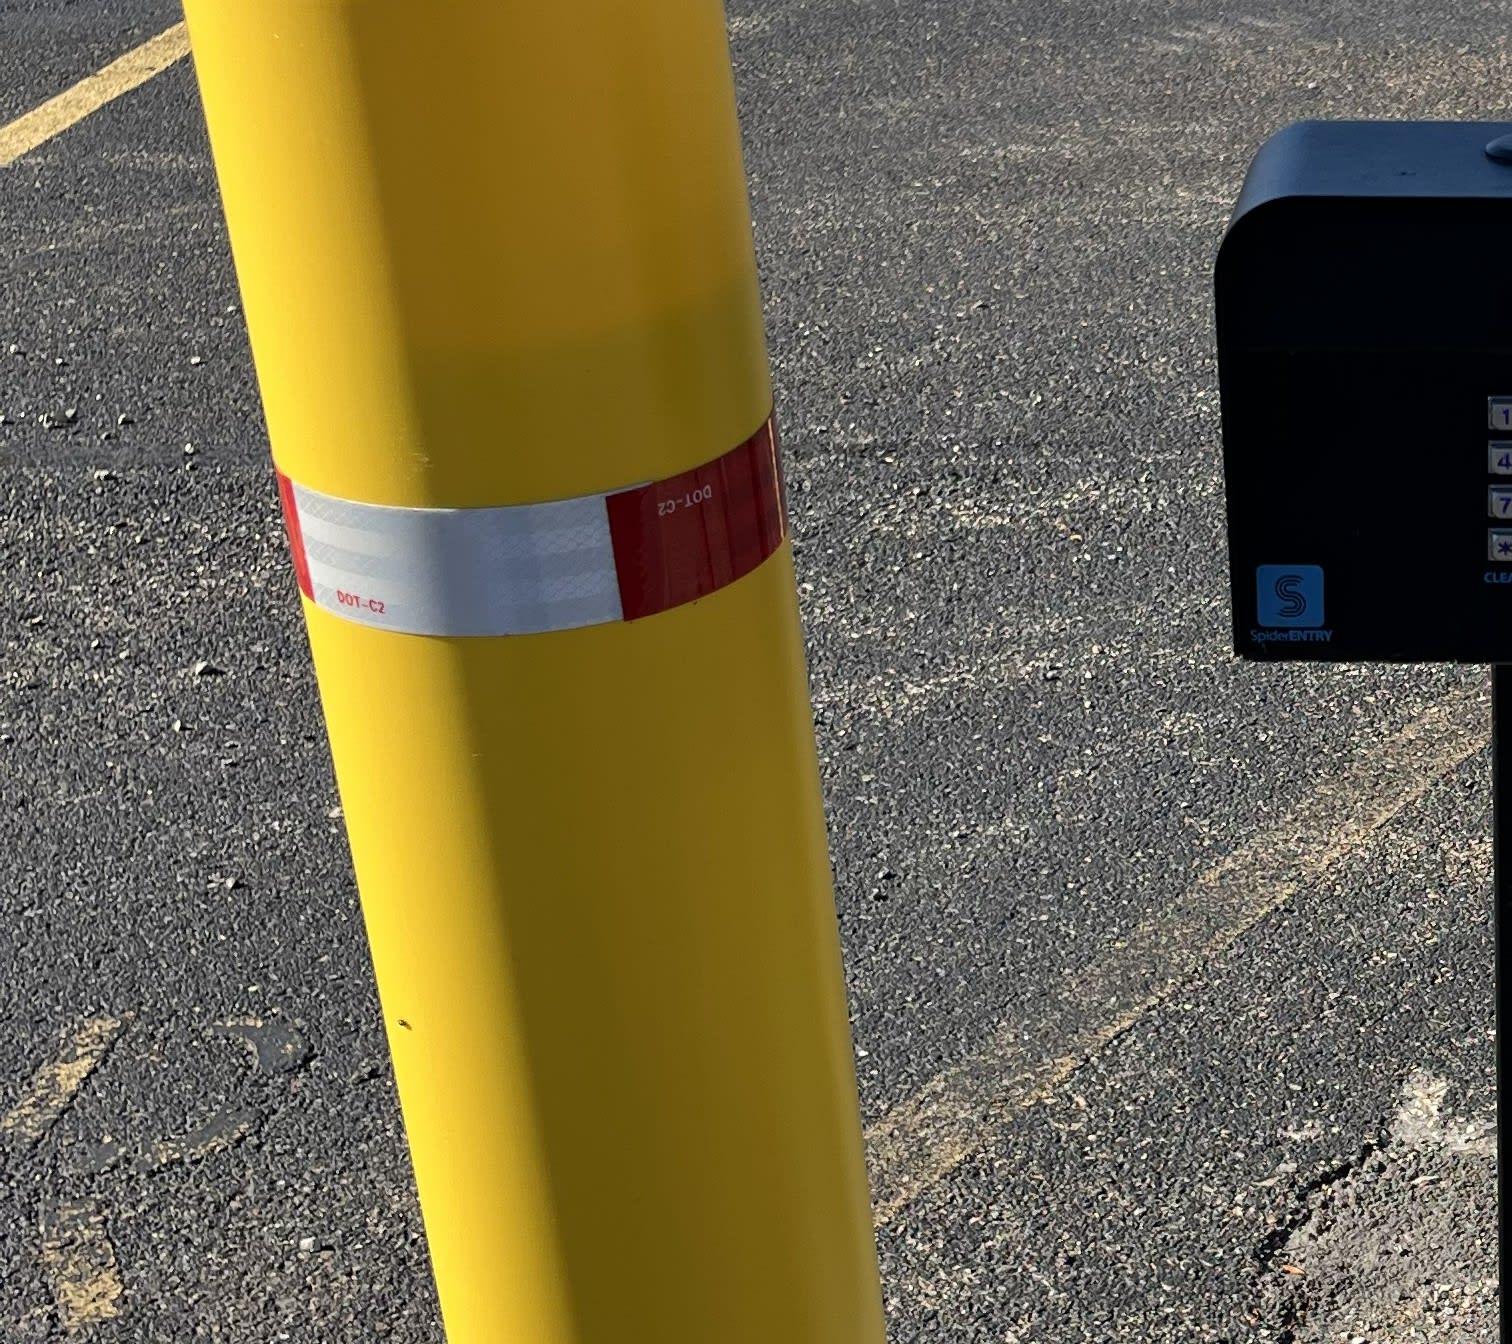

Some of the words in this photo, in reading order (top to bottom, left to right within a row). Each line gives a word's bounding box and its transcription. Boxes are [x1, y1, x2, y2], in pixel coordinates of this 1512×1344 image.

[1497, 452, 1512, 470] 4
[657, 484, 713, 516] DOT-C2
[1499, 497, 1512, 514] 7
[336, 589, 386, 614] DOT-C2
[1250, 629, 1333, 643] SpiderENTRY
